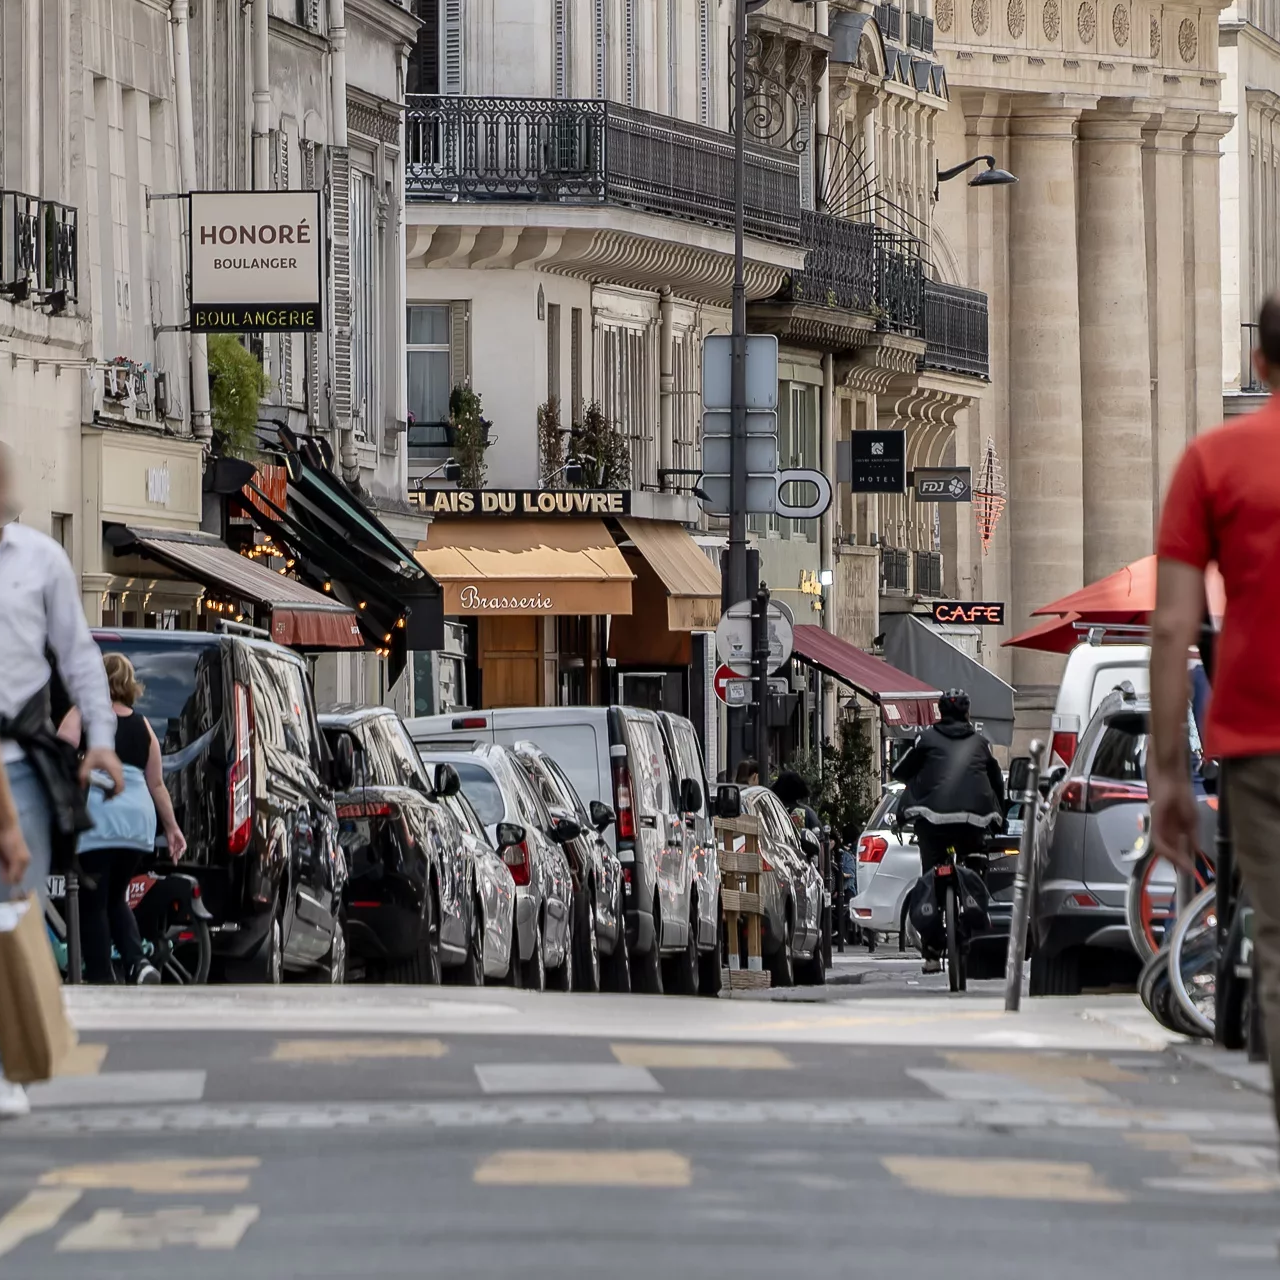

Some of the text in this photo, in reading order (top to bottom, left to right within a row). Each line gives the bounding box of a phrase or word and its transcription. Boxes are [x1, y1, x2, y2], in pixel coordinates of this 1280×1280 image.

[200, 218, 311, 245] HONORÉ
[214, 258, 298, 270] BOULANGER
[196, 310, 315, 326] BOULANGERIE
[922, 481, 944, 492] FDJ
[481, 492, 516, 513] DU
[524, 492, 624, 513] LOUVRE
[460, 585, 553, 610] Brasserie
[935, 605, 1001, 622] CAFE
